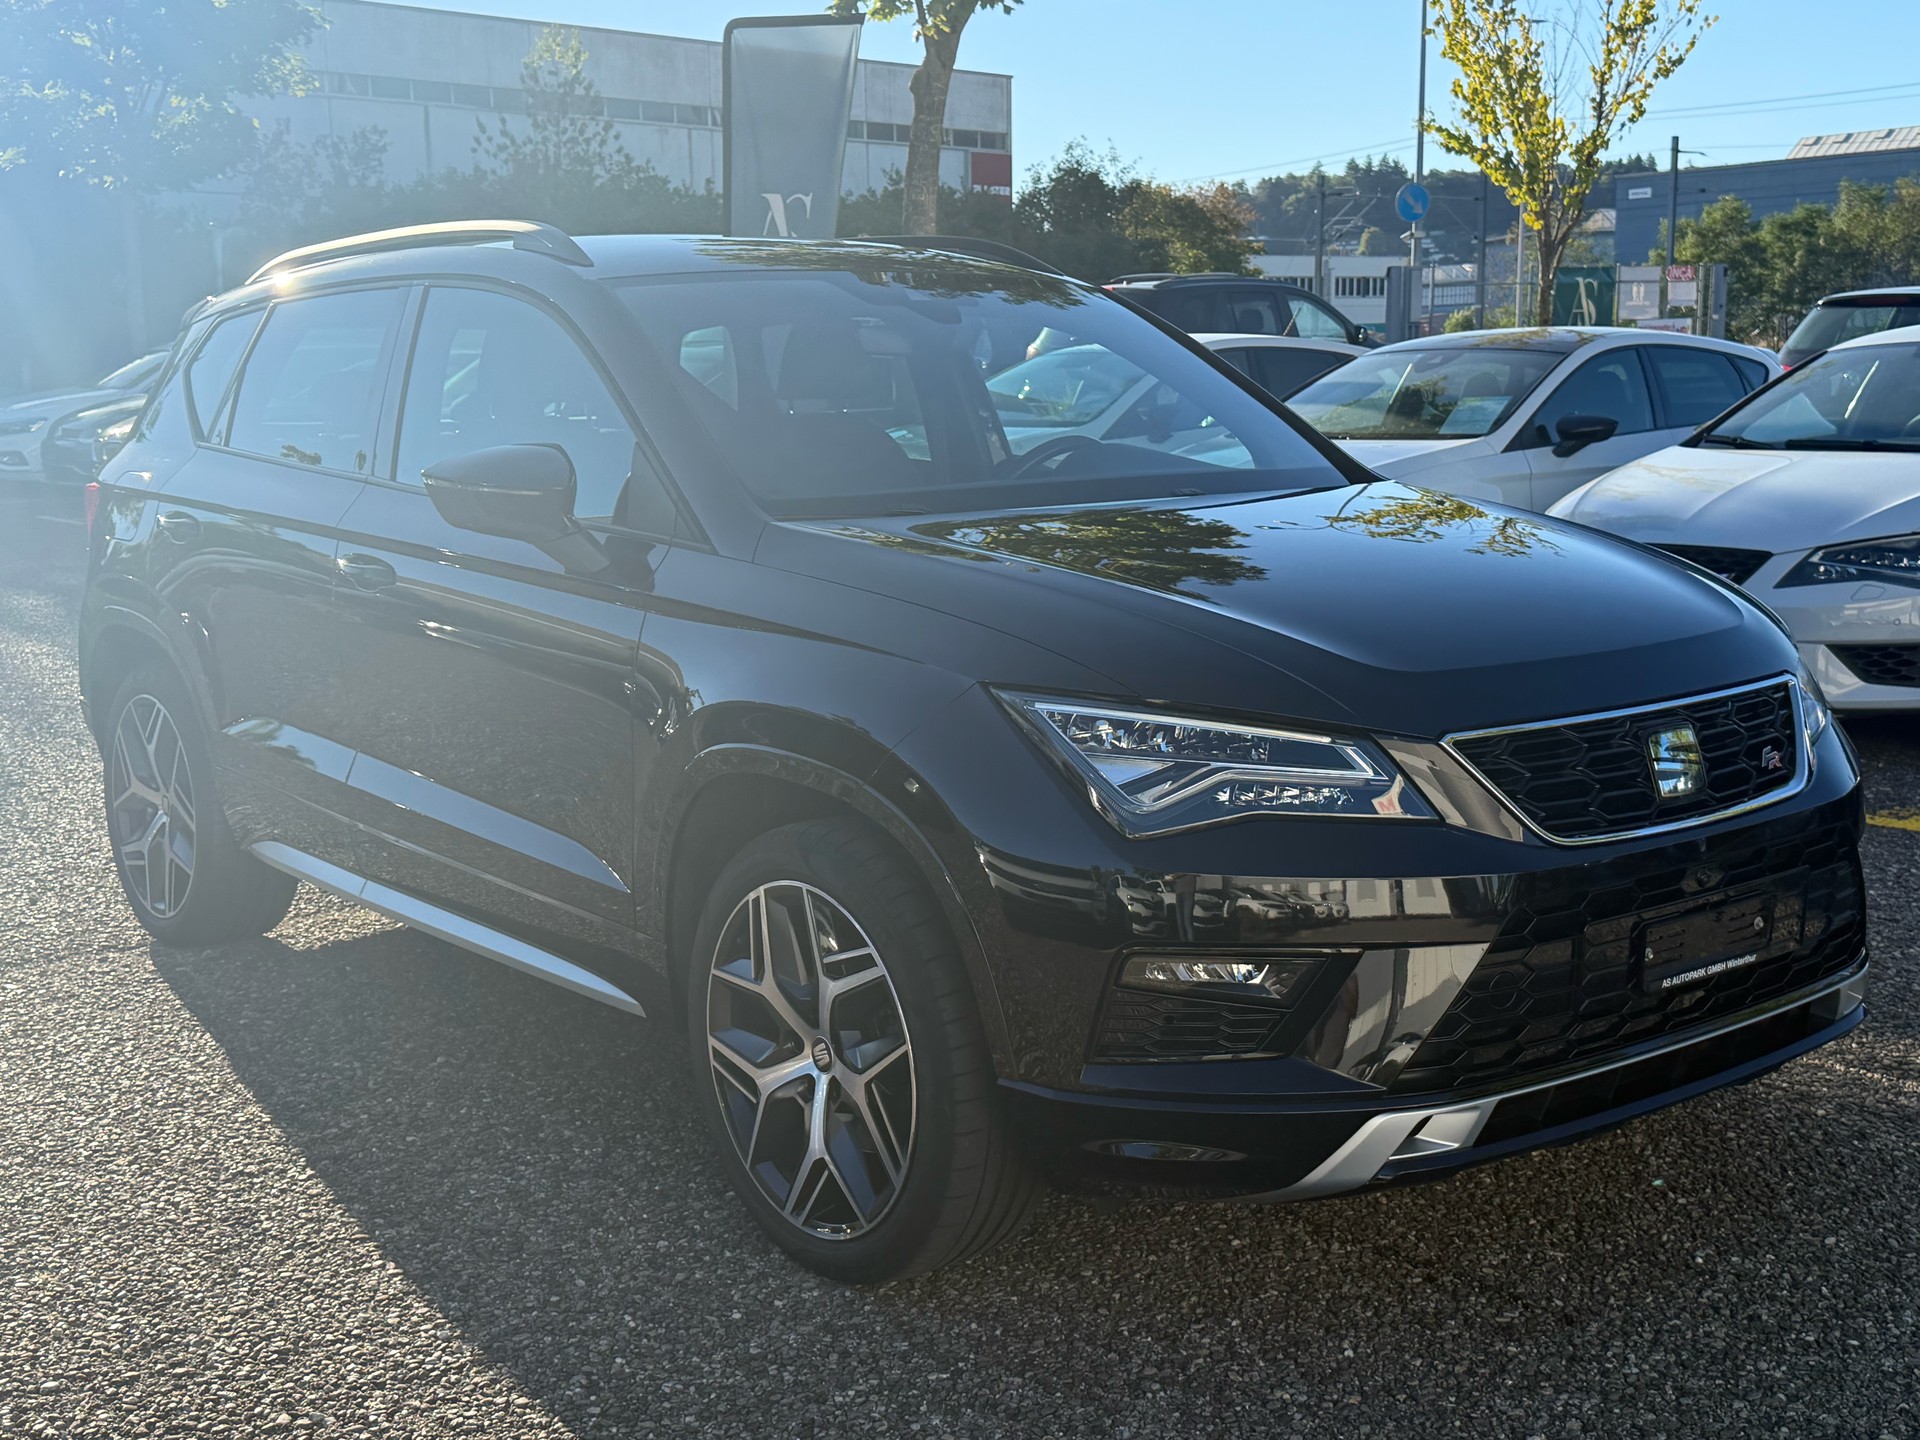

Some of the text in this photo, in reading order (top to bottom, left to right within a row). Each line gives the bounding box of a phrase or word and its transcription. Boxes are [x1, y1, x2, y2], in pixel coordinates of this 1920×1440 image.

[1661, 953, 1757, 988] AS AUTOPARK GMBH Winterthur
